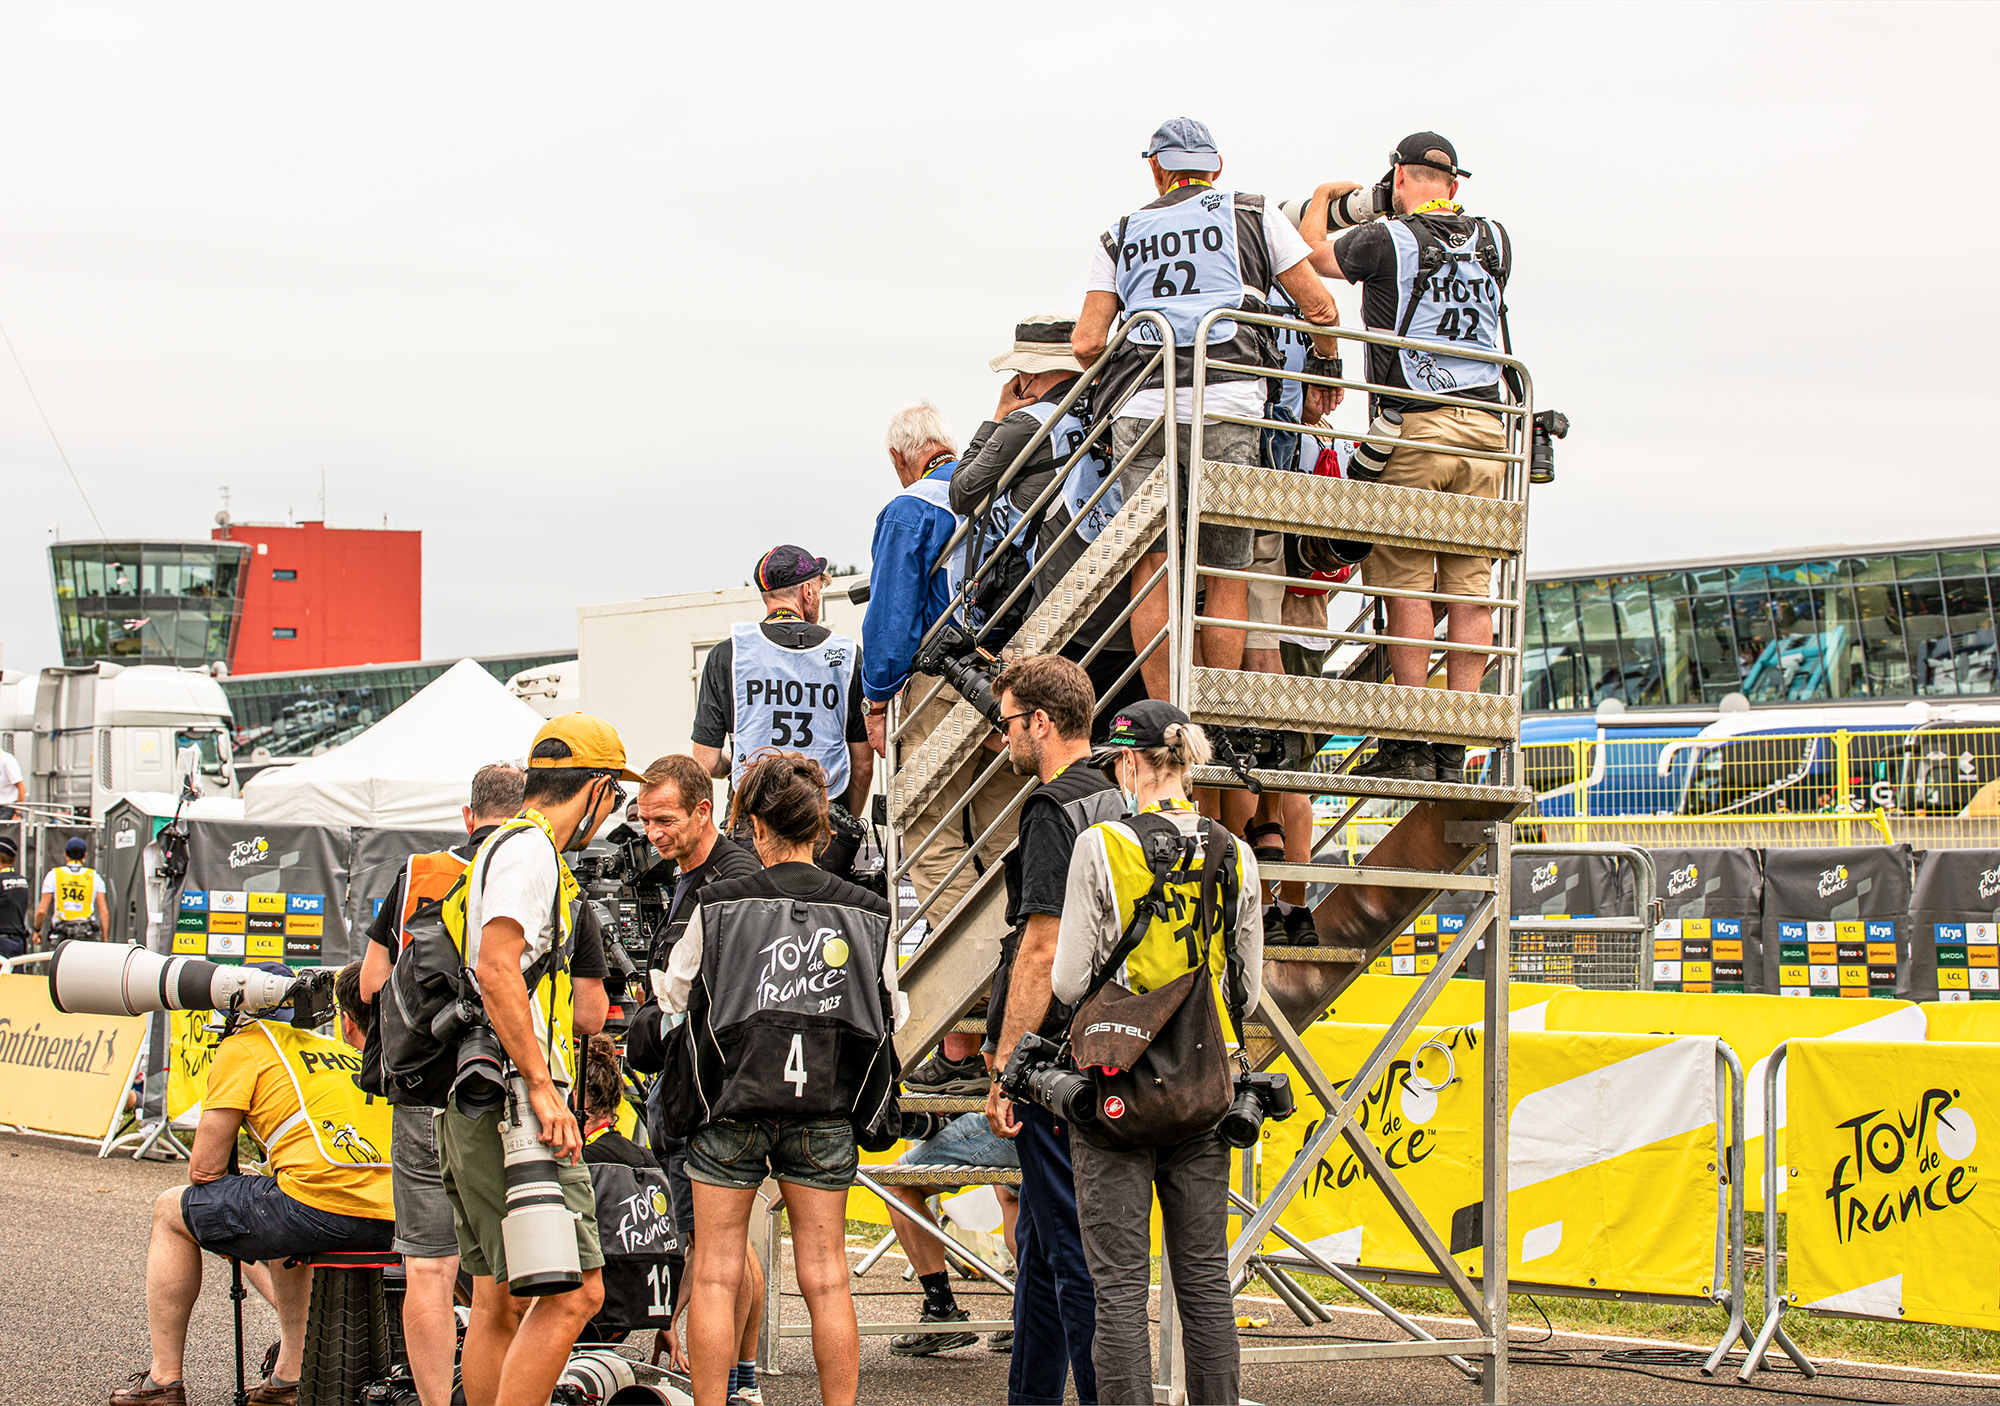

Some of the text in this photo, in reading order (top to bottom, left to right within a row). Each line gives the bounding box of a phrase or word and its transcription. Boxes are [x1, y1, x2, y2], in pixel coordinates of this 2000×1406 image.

[1122, 225, 1223, 272] PHOTO
[1152, 260, 1200, 298] 62
[1436, 308, 1479, 341] 42
[746, 679, 838, 710] PHOTO
[771, 711, 813, 747] 53
[232, 836, 265, 856] TOUR
[1533, 861, 1556, 881] TOUR
[1670, 864, 1695, 884] TOUR
[1820, 864, 1845, 885] TOUR
[62, 888, 84, 900] 346
[292, 897, 319, 910] Krys
[1442, 918, 1463, 929] Krys
[1717, 922, 1739, 935] Krys
[1783, 925, 1803, 938] Krys
[1870, 925, 1891, 937] Krys
[1940, 927, 1962, 940] Krys
[759, 927, 843, 976] TOUR
[808, 956, 824, 972] de
[818, 995, 842, 1013] 2023
[784, 1034, 807, 1097] 4
[1382, 1111, 1402, 1136] de
[1835, 1088, 1960, 1183] TOUR
[1919, 1144, 1941, 1174] de
[647, 1264, 672, 1316] 12
